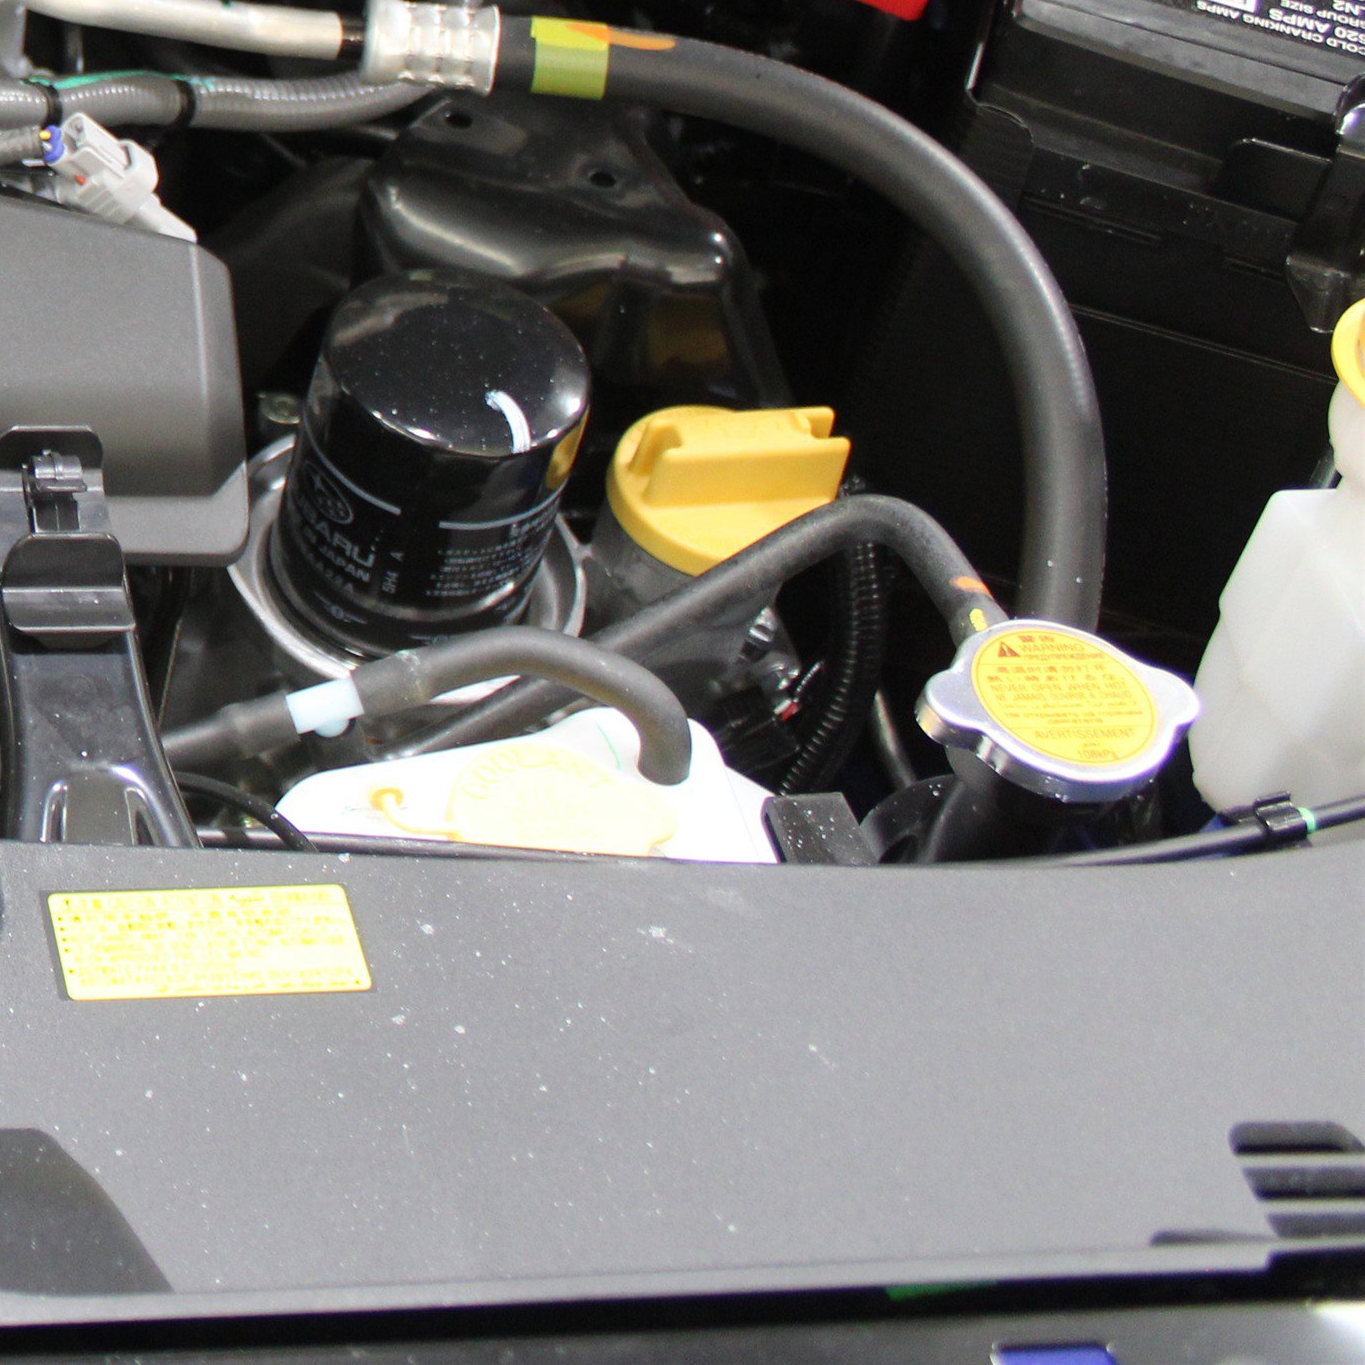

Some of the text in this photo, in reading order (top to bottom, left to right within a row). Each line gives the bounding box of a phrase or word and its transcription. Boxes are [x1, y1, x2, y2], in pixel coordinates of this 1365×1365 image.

[1269, 7, 1330, 33] AMPS
[1196, 0, 1365, 56] COLD CRANKING AMPS
[1019, 643, 1085, 652] WARNING
[990, 680, 1126, 692] NEVER OPEN WHEN HOT
[1035, 728, 1135, 739] AVERTISSEMENT
